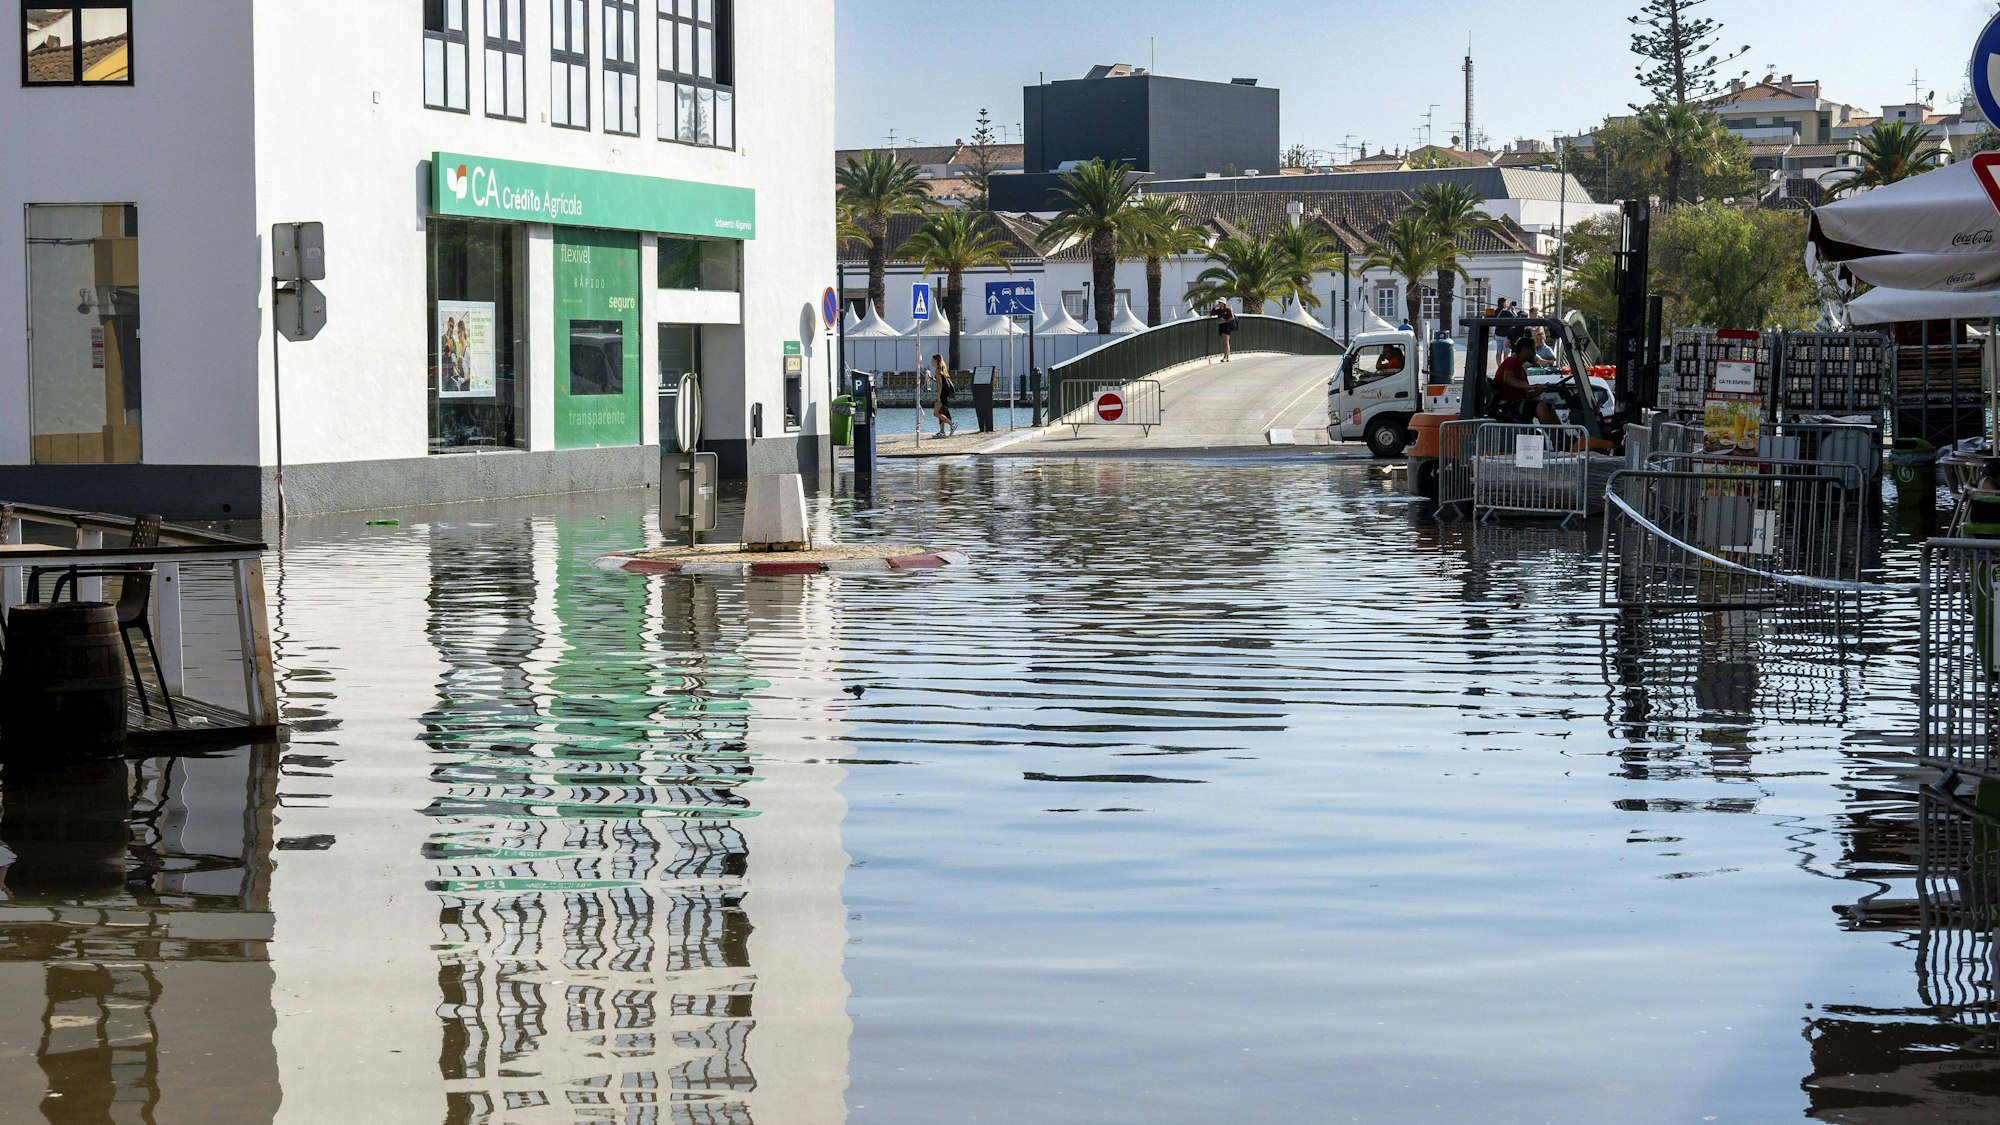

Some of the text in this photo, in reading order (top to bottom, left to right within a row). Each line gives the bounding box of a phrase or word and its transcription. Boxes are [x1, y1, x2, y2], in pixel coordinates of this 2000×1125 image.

[472, 166, 582, 218] CA Crédito Agrícola
[1952, 229, 1993, 246] Coca-Cola
[561, 244, 591, 263] flexível
[608, 296, 635, 312] seguro
[855, 380, 862, 390] P
[1627, 360, 1635, 393] TOYOTA
[569, 410, 625, 429] transparente
